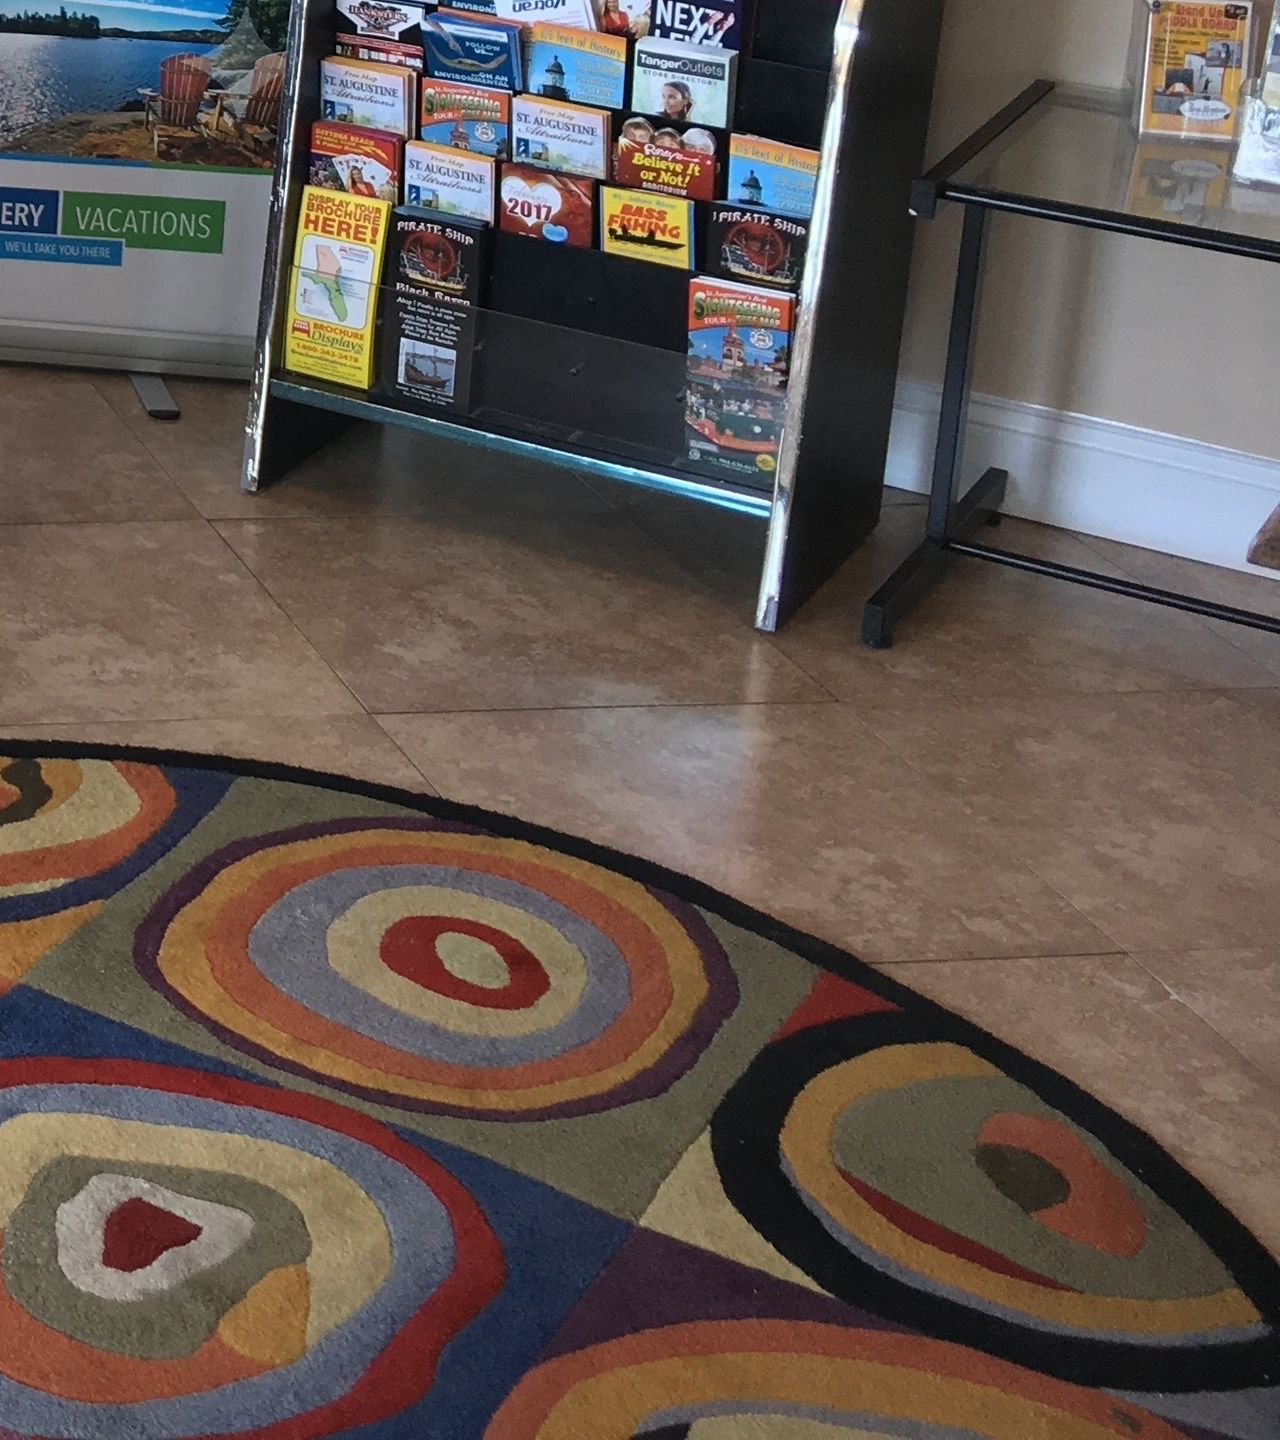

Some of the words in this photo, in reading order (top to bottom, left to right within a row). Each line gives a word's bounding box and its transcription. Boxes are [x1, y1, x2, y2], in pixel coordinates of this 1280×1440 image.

[465, 41, 500, 51] FOLLOW
[640, 53, 724, 77] TangerOutlets
[323, 75, 337, 86] ST.
[338, 78, 398, 98] AUGUSTINE
[434, 70, 510, 87] ENVIRONMENTAL
[643, 69, 669, 79] STORE
[671, 72, 718, 86] DIRECTORY
[331, 88, 395, 107] Attractions
[425, 88, 501, 115] SIGHTSEEING
[433, 111, 454, 120] TOUR
[516, 112, 531, 124] ST.
[533, 117, 598, 137] AUGUSTINE
[350, 135, 375, 146] BEACH
[525, 127, 594, 146] Attractions
[408, 159, 423, 171] ST.
[424, 164, 486, 185] AUGUSTINE
[632, 152, 684, 173] Believe
[686, 162, 701, 176] It
[416, 173, 482, 194] Attractions
[640, 170, 657, 181] or
[658, 171, 690, 187] Not!
[306, 201, 381, 227] BROCHURE
[308, 192, 352, 209] DISPLAY
[354, 203, 383, 217] YOUR
[508, 197, 552, 222] 2017
[620, 203, 668, 221] BASS
[74, 206, 212, 239] VACATIONS
[304, 212, 380, 244] HERE!
[397, 221, 441, 236] PIRATE
[443, 227, 474, 246] SHIP
[607, 214, 681, 240] FISHING
[719, 211, 770, 226] PIRATE
[774, 217, 806, 236] SHIP
[5, 240, 33, 253] WE'LL
[33, 241, 57, 255] TAKE
[59, 243, 80, 256] YOU
[81, 244, 111, 258] THERE
[396, 282, 429, 297] Black
[434, 291, 471, 307] Raven
[694, 292, 781, 320] SIGHTSEEING
[313, 322, 365, 340] BROCHURE
[703, 316, 727, 325] TOUR
[312, 330, 364, 352] Displays
